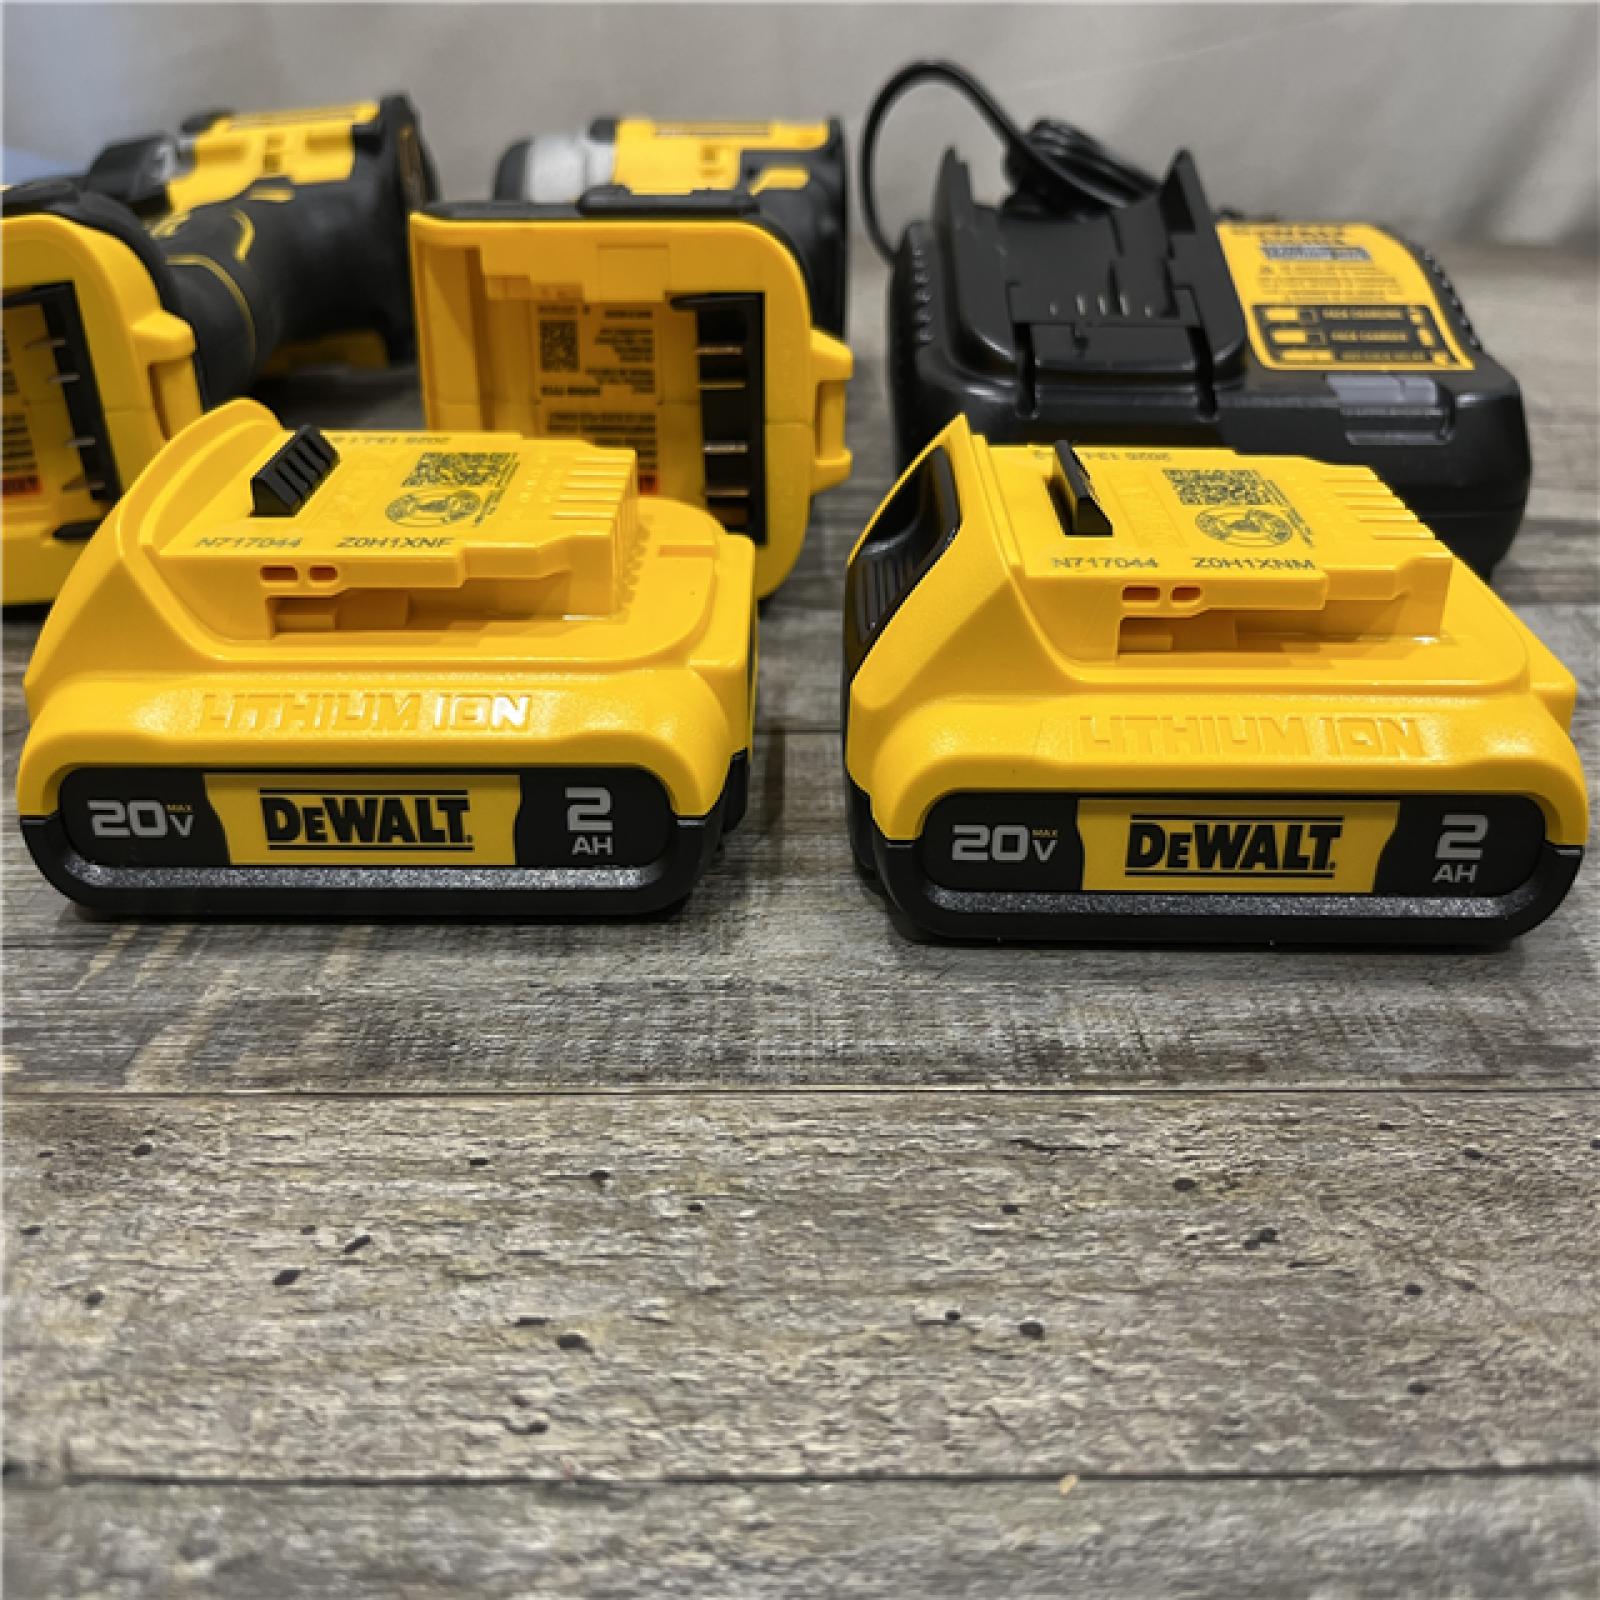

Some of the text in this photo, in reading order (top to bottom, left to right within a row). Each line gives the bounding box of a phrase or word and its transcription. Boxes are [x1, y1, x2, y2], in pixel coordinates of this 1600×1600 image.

[194, 536, 303, 549] N717044
[1051, 556, 1160, 570] N717044
[199, 692, 533, 731] LITHIUM ION
[1078, 714, 1428, 758] LITHIUM ION
[564, 786, 614, 831] 2
[571, 835, 614, 856] AH
[1434, 814, 1489, 860] 2
[1431, 863, 1479, 884] AH
